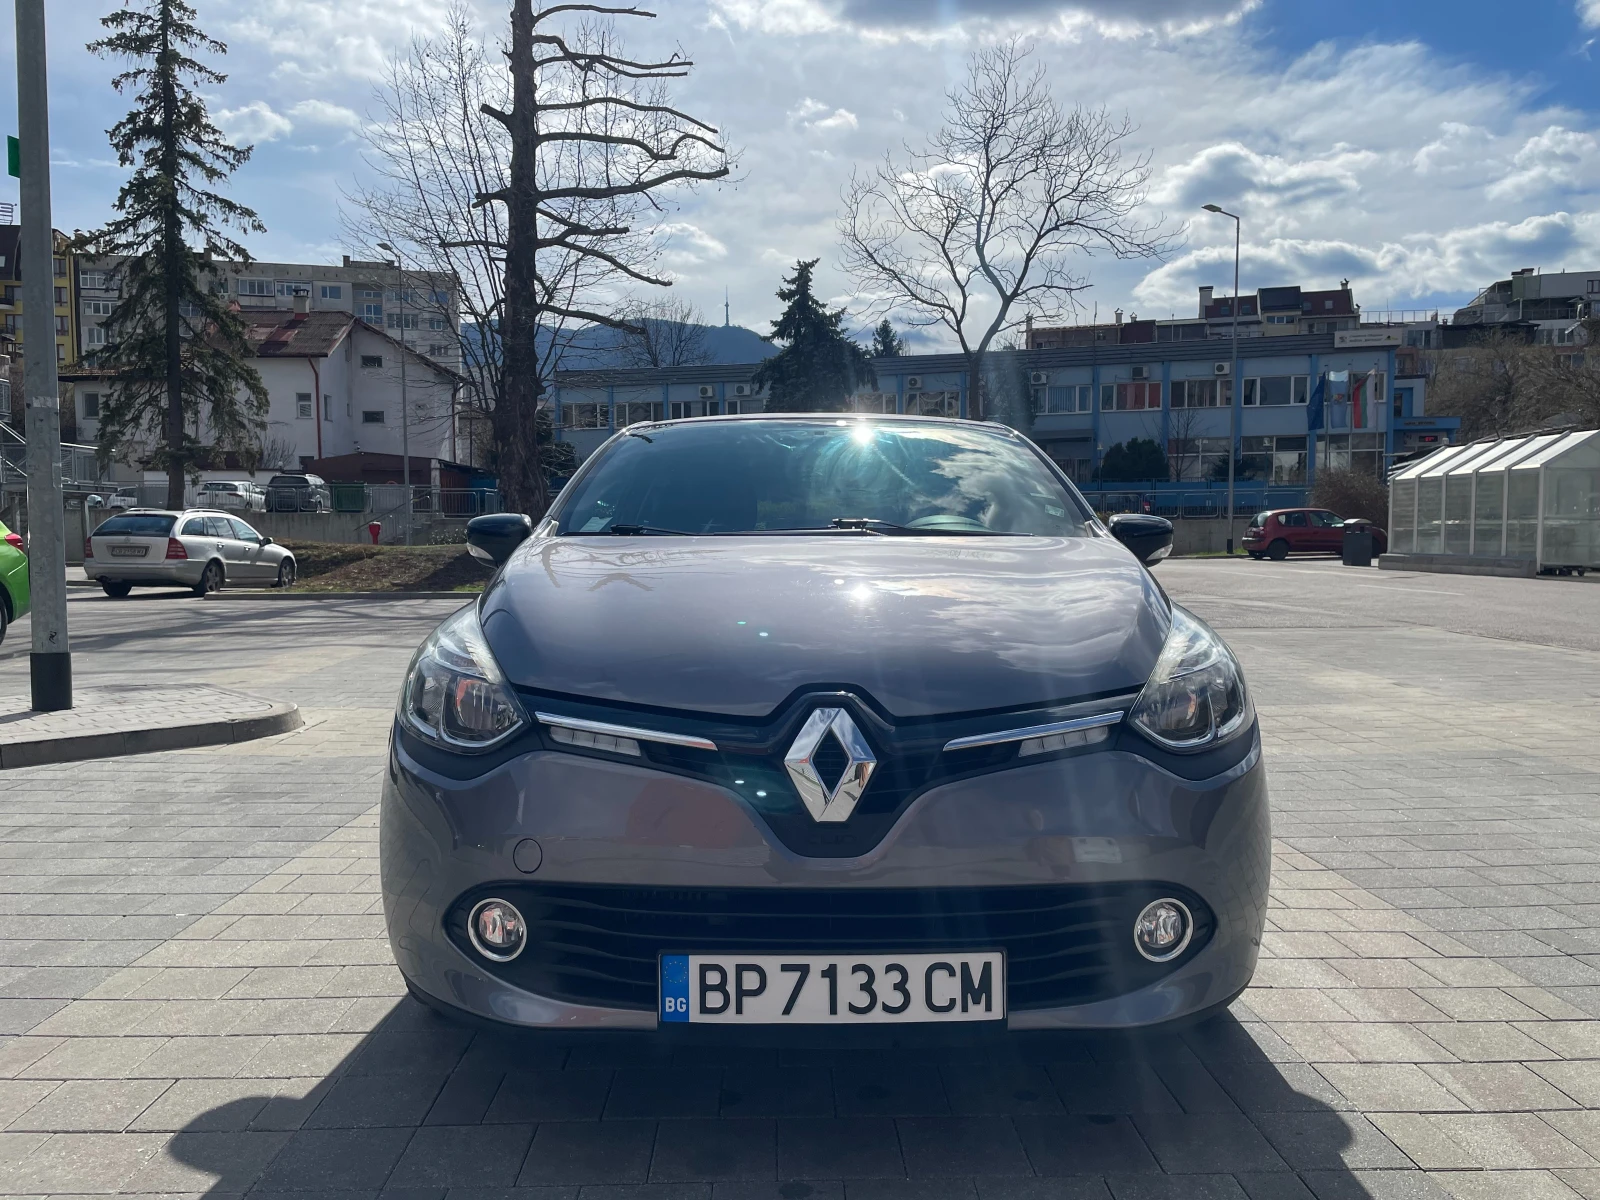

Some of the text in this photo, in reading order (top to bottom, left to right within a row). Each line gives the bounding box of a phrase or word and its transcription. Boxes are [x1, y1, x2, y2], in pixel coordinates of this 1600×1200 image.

[665, 997, 687, 1012] BG
[699, 961, 993, 1016] BP 7133 CM
